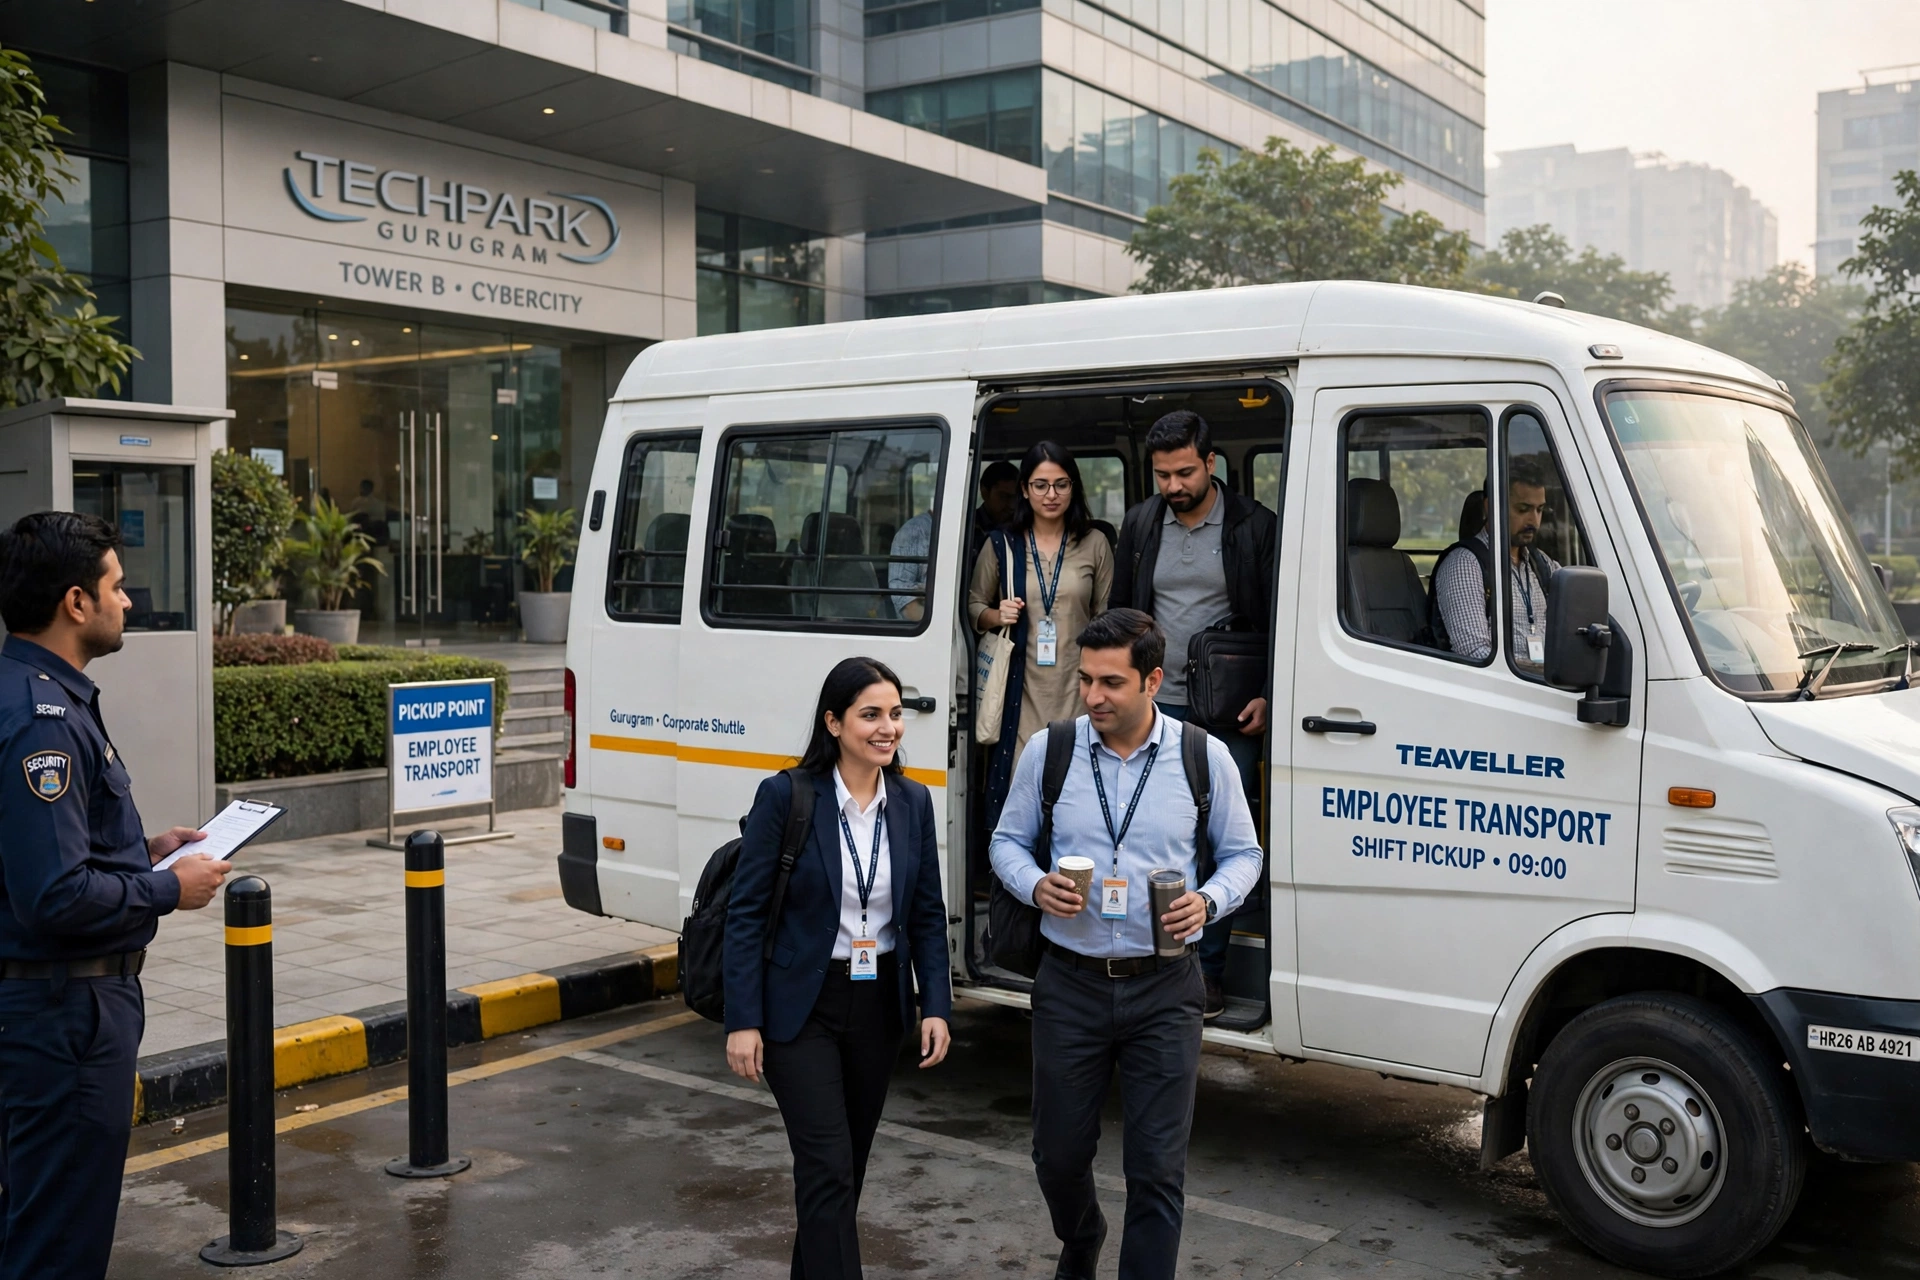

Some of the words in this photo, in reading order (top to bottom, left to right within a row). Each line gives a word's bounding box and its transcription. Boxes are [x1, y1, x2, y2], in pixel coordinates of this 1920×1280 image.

[295, 151, 592, 248] TECHPARK
[377, 221, 548, 265] GURUGRAM
[339, 261, 422, 294] TOWER
[432, 275, 446, 296] B
[471, 281, 583, 315] CYBERCITY
[398, 701, 446, 721] PICKUP
[448, 698, 486, 718] POINT
[610, 708, 654, 729] Gurugram
[662, 713, 709, 733] Corporate
[711, 718, 746, 735] Shuttle
[408, 736, 477, 758] EMPLOYEE
[1396, 743, 1566, 780] TEAVELLER
[27, 756, 67, 773] SECURITY
[404, 758, 481, 782] TRANSPORT
[1321, 786, 1448, 830] EMPLOYEE
[1454, 799, 1612, 846] TRANSPORT
[1351, 835, 1408, 861] SHIFT
[1412, 842, 1486, 870] PICKUP
[1508, 852, 1567, 880] 09:00
[1819, 1030, 1853, 1049] HR26
[1856, 1034, 1875, 1052] AB
[1878, 1037, 1912, 1057] 4921
